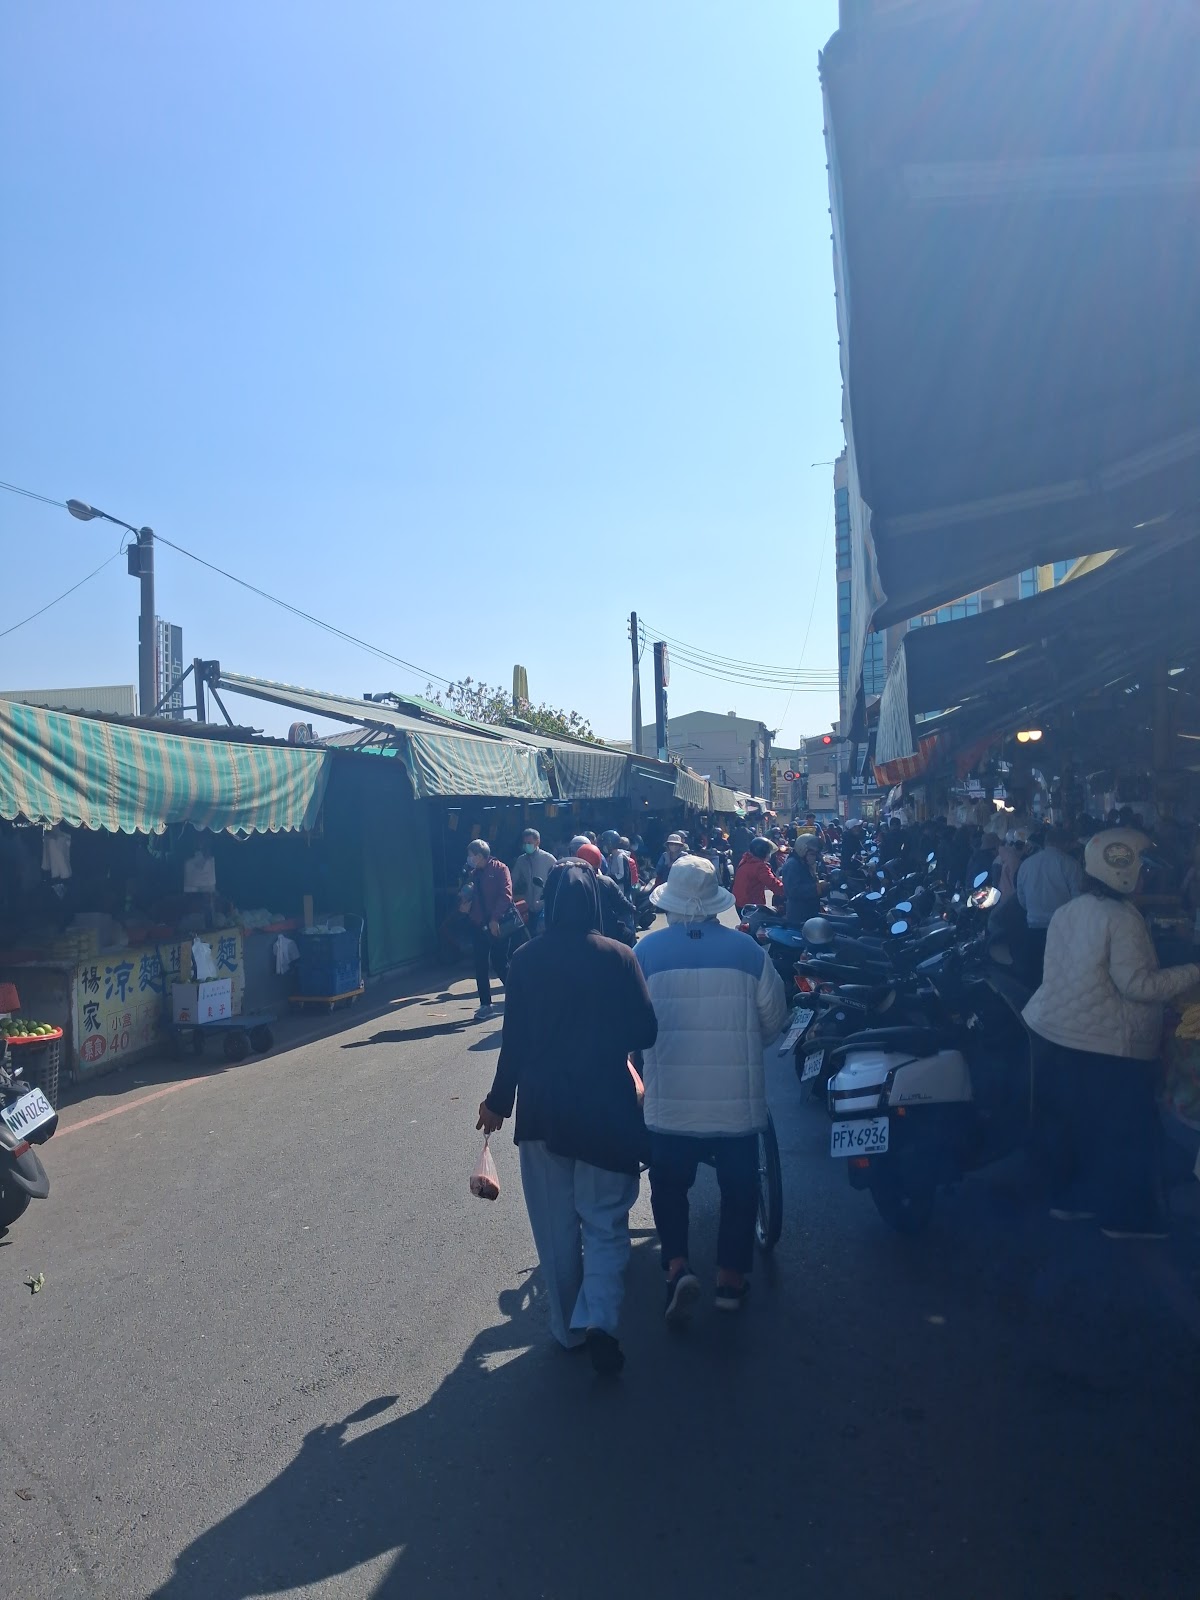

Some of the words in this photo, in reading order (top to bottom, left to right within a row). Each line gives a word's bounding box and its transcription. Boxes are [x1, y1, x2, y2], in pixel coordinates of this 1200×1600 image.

[104, 954, 163, 1003] 涼麵
[81, 966, 102, 1033] 楊家
[83, 1038, 104, 1062] 素食
[109, 1031, 131, 1053] 40
